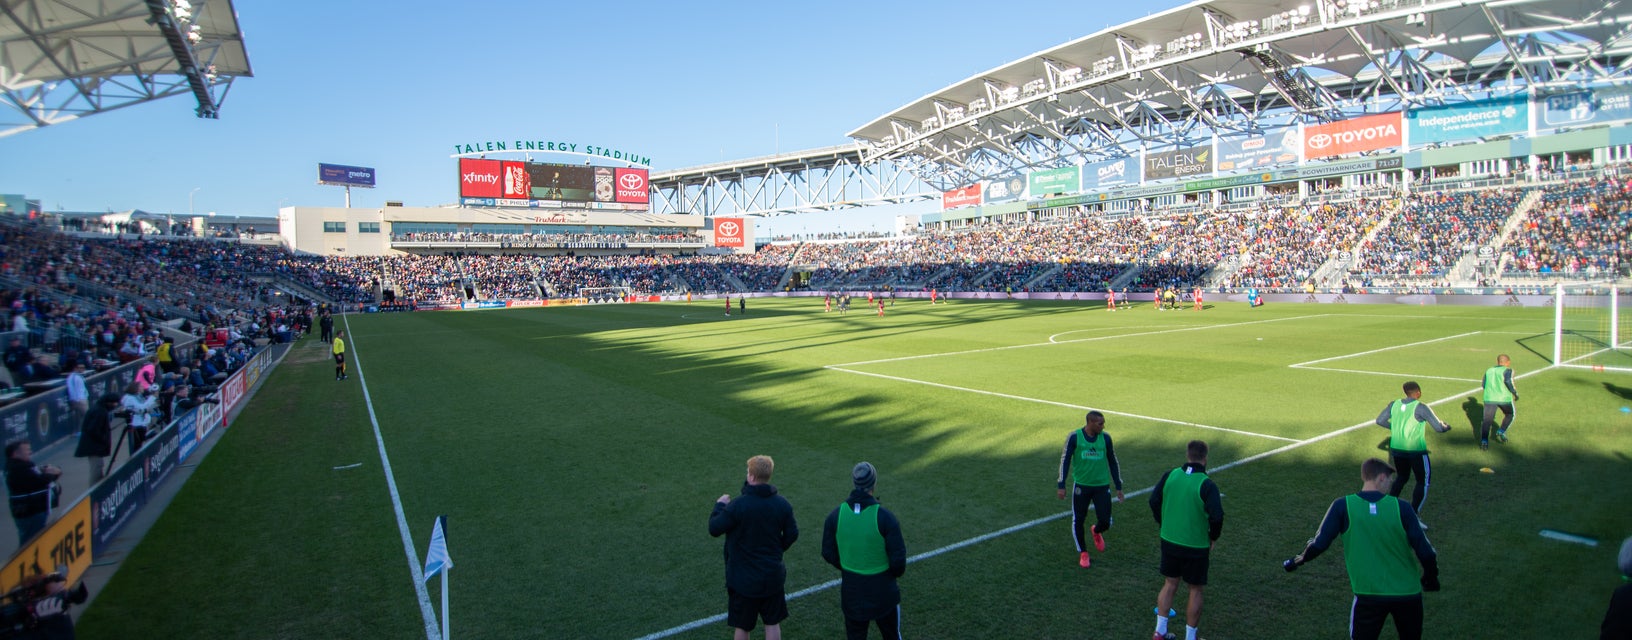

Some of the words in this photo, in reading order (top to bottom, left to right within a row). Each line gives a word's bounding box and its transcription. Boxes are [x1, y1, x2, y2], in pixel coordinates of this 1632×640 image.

[1601, 95, 1630, 104] HOME
[1601, 103, 1613, 111] OF
[1614, 101, 1630, 109] THE
[1419, 109, 1500, 127] Independence
[1570, 106, 1588, 120] 17
[1332, 124, 1397, 144] TOYOTA
[455, 141, 506, 154] TALEN
[515, 140, 577, 153] ENERGY
[586, 145, 651, 166] STADIUM
[1149, 152, 1194, 170] TALEN
[349, 171, 371, 179] metro
[1174, 163, 1206, 175] ENERGY
[1302, 162, 1373, 175] #GOWITHARNICARE
[463, 171, 499, 185] xfinity
[513, 165, 524, 195] Coca-Cola
[618, 190, 647, 198] TOYOTA
[534, 214, 567, 223] TruMark
[50, 519, 86, 572] TIRE
